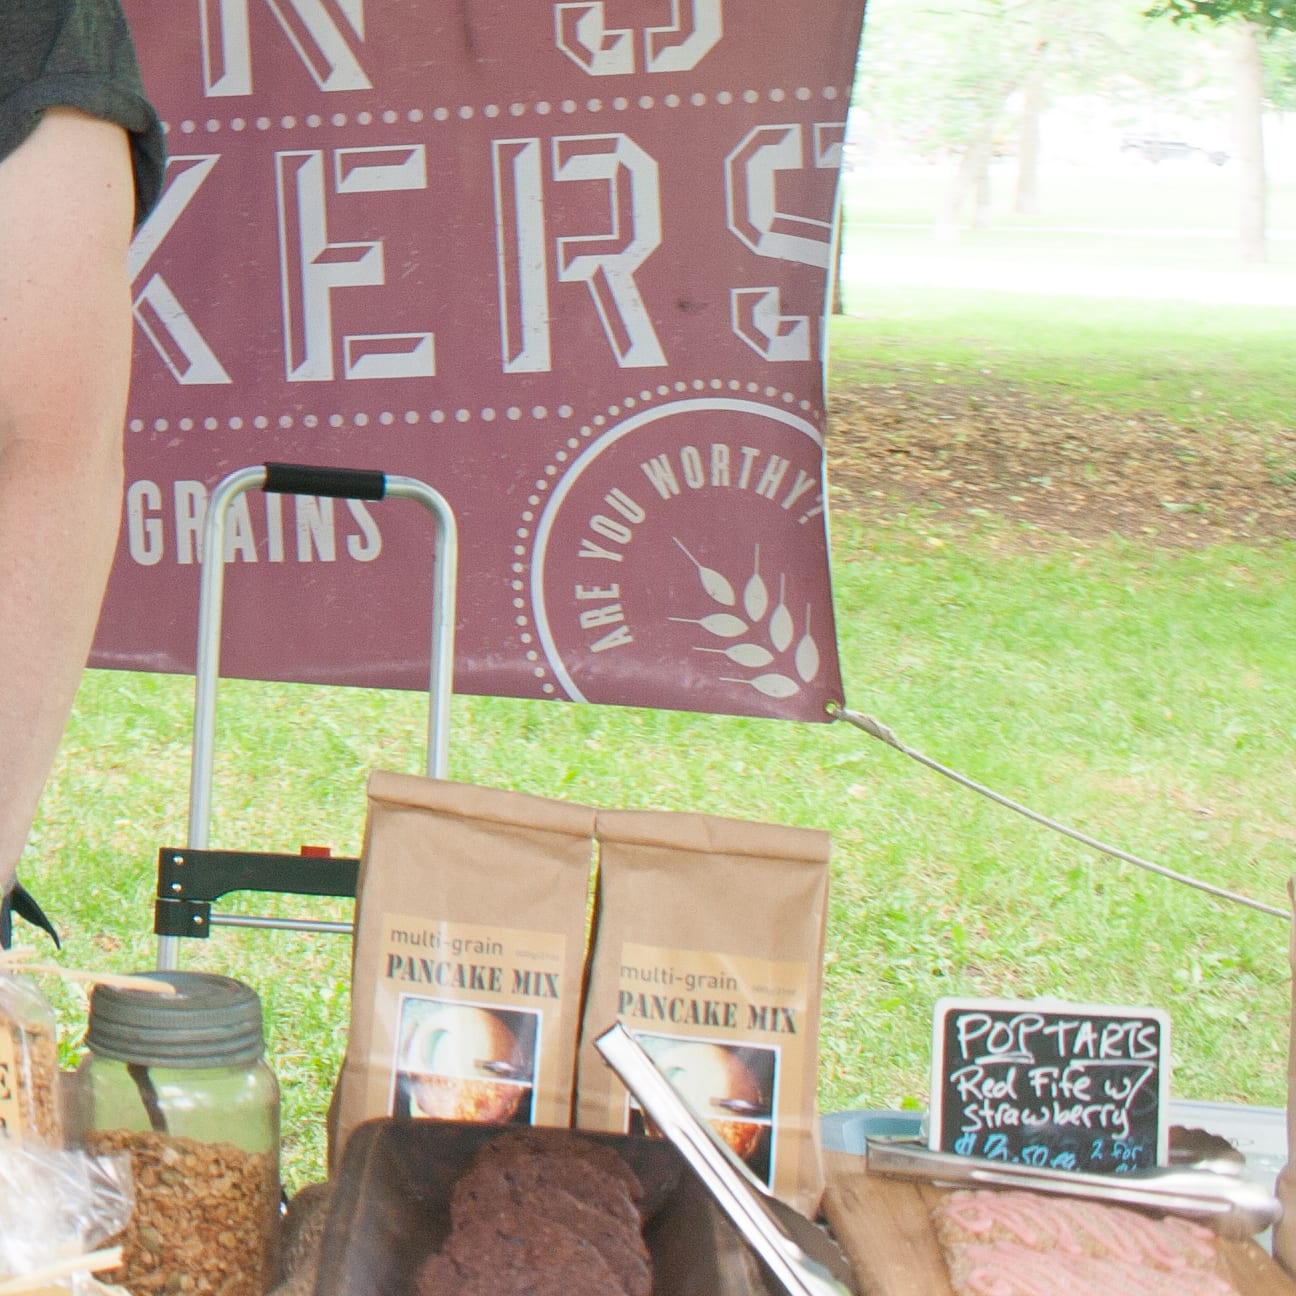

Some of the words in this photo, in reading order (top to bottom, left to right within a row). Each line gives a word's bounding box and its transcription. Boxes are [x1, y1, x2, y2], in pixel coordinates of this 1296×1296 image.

[126, 479, 383, 566] GRAINS
[577, 487, 646, 562] YOU
[574, 583, 634, 653] ARE
[389, 925, 504, 959] multi-grain
[385, 952, 503, 992] PANCAKE
[512, 968, 561, 1001] MIX
[619, 964, 739, 992] multi-grain
[617, 989, 739, 1030] PANCAKE
[746, 1003, 799, 1035] MIX
[950, 1064, 1019, 1102] Red
